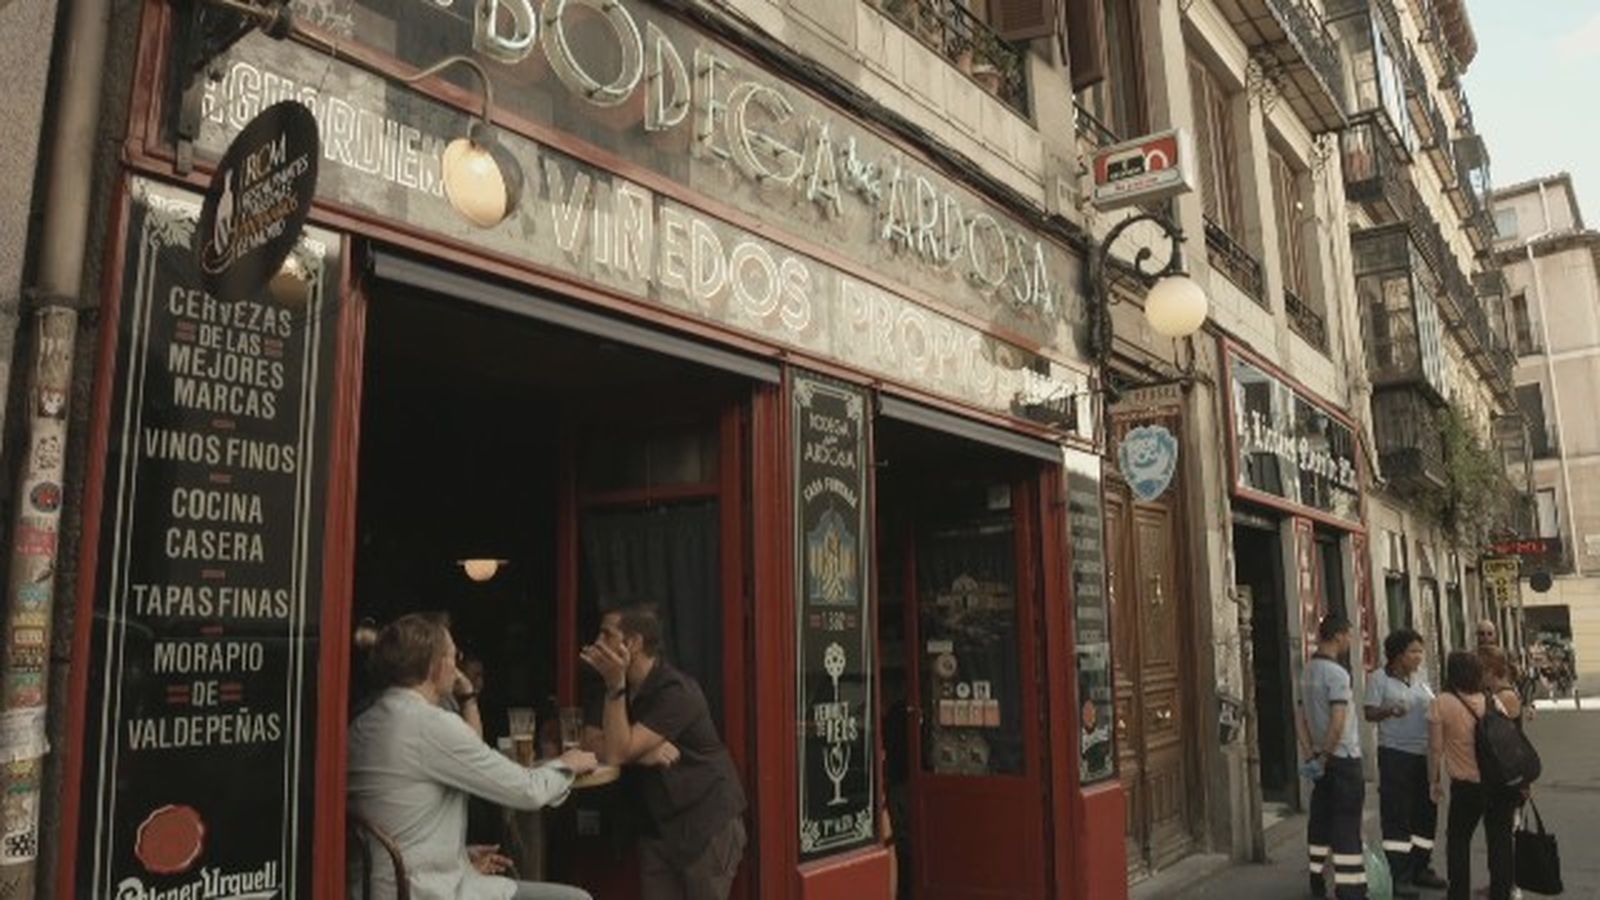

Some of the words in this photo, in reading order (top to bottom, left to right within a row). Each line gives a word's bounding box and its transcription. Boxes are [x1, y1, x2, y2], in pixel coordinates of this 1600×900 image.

[882, 166, 1056, 318] ARDOSA
[169, 285, 292, 338] CERVEZAS
[200, 323, 222, 347] DE
[226, 327, 261, 358] LAS
[168, 342, 285, 390] MEJORES
[173, 377, 277, 420] MARCAS
[145, 427, 221, 465] VINOS
[226, 438, 296, 474] FINOS
[171, 487, 264, 524] COCINA
[166, 527, 264, 562] CASERA
[132, 584, 214, 618] TAPAS
[217, 588, 289, 620] FINAS
[154, 641, 264, 674] MORAPIO
[191, 680, 219, 707] DE
[128, 707, 281, 750] VALDEPEÑAS
[200, 860, 278, 899] Urquell
